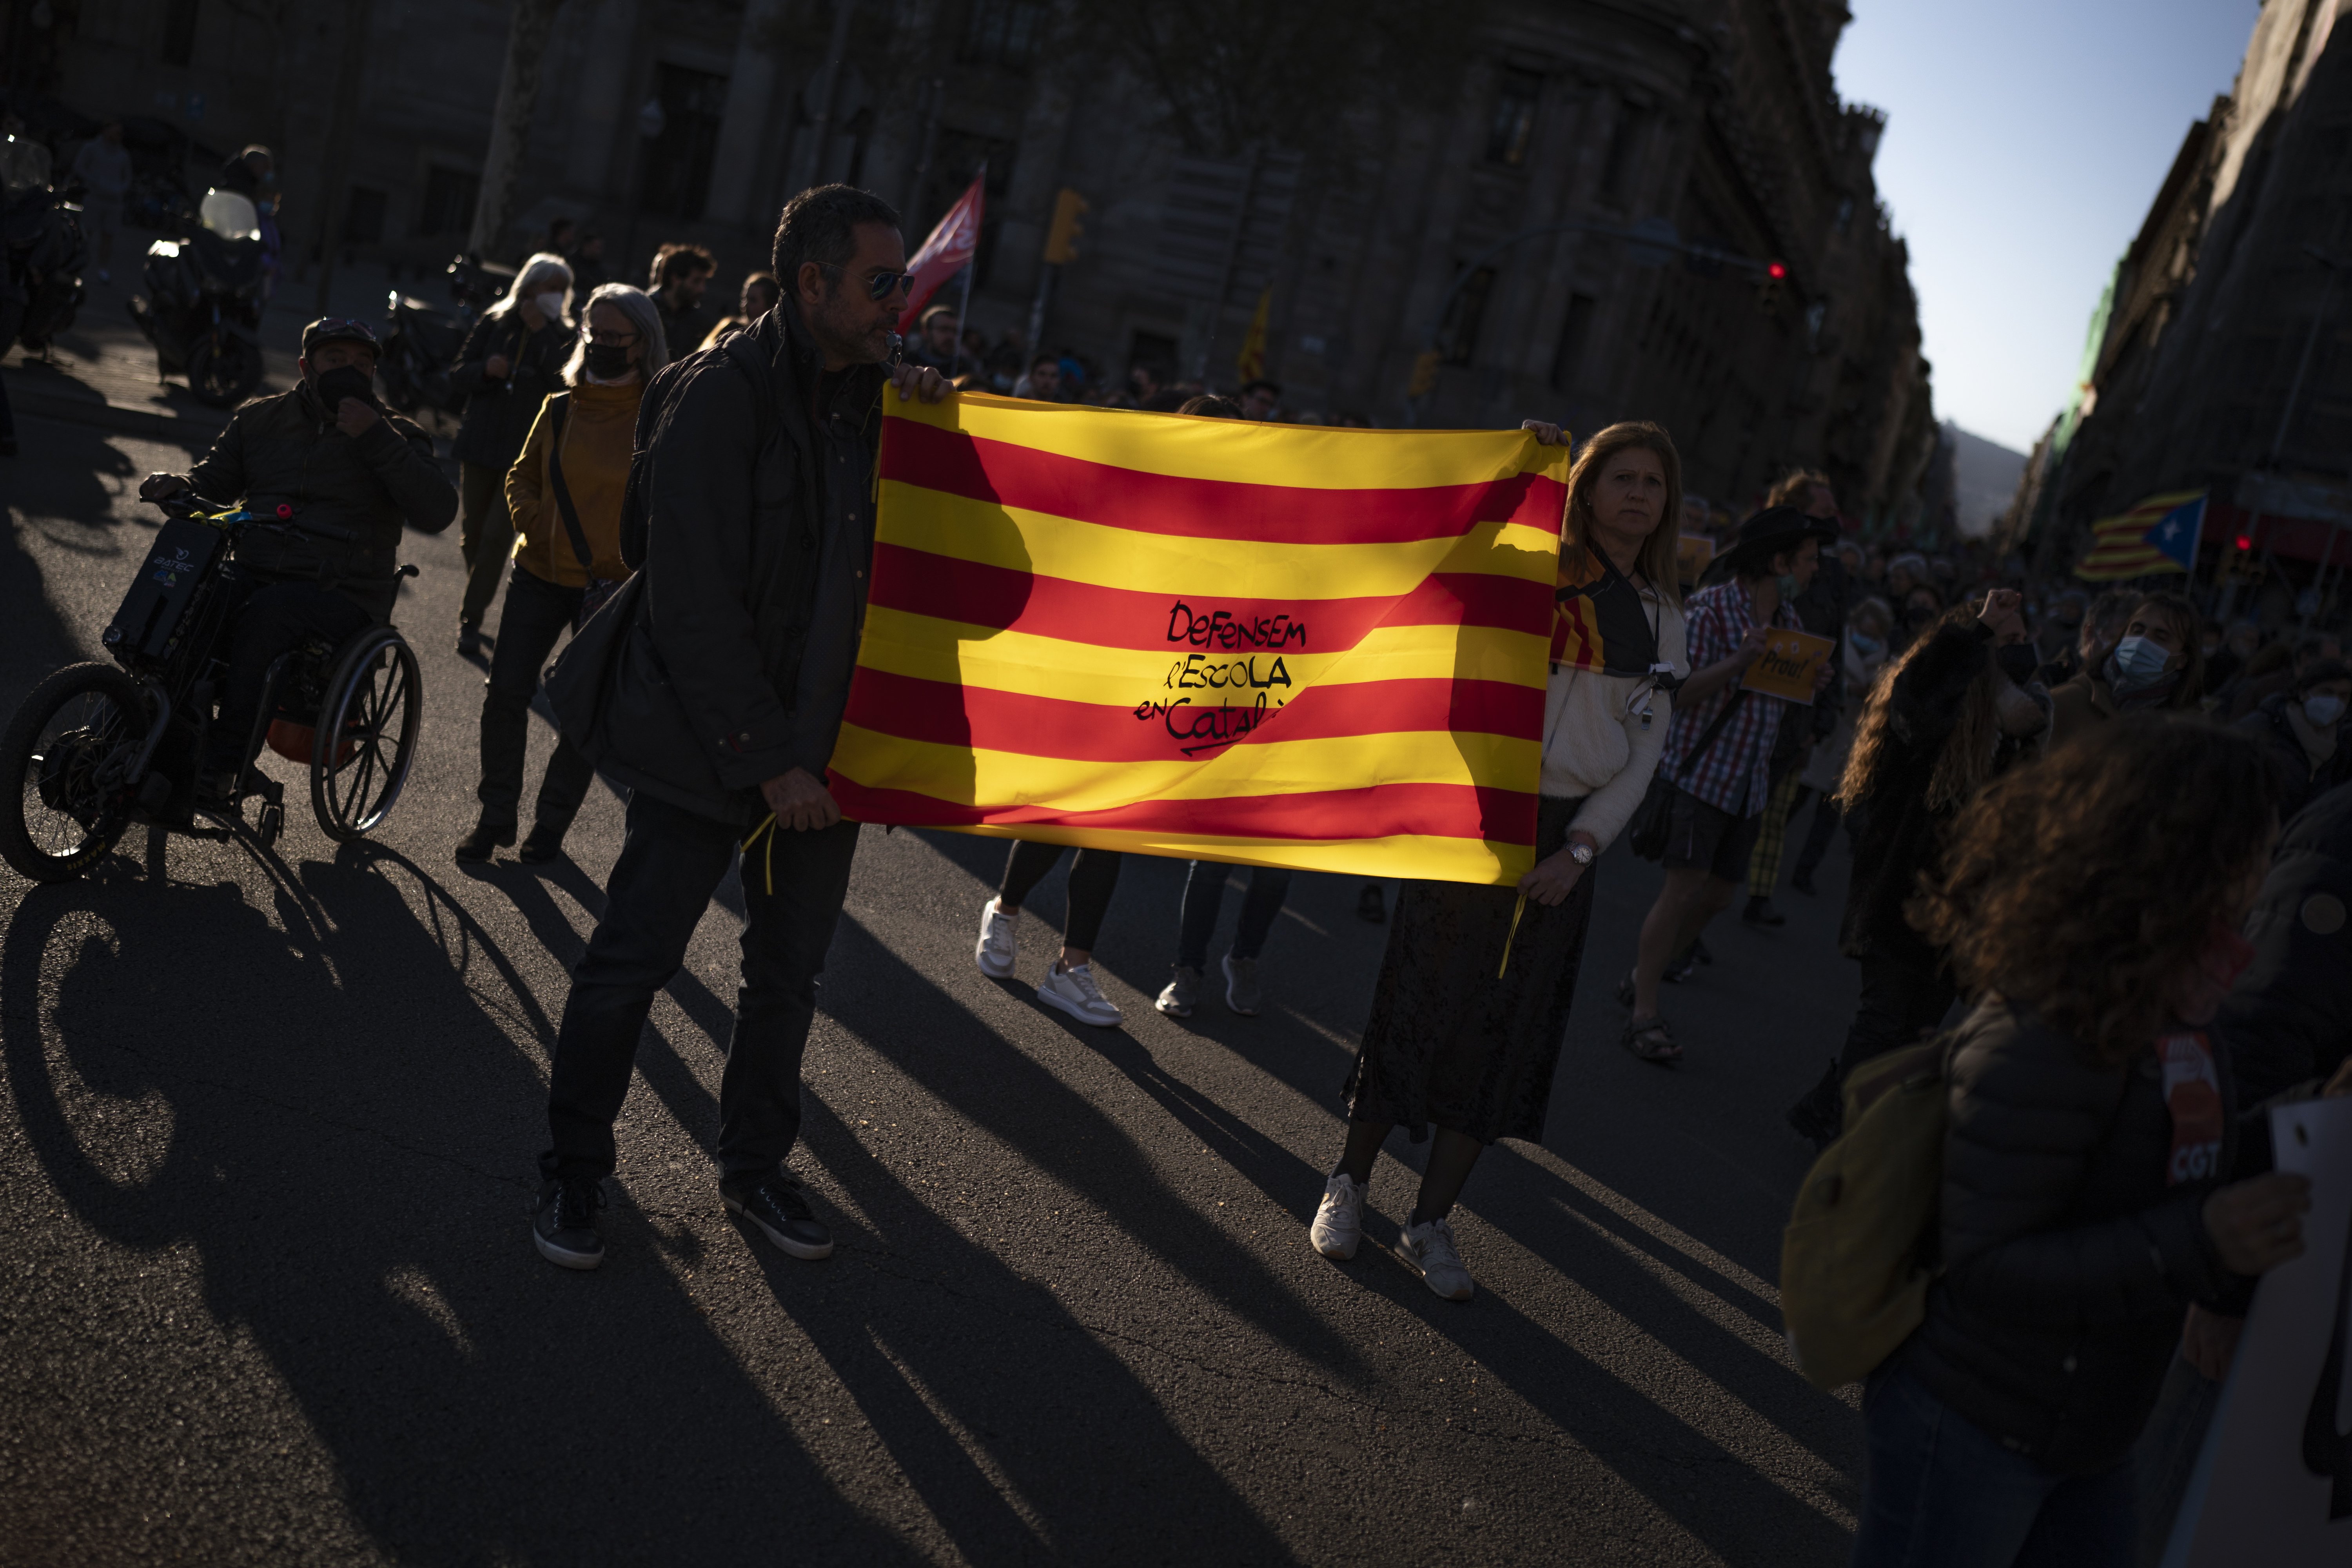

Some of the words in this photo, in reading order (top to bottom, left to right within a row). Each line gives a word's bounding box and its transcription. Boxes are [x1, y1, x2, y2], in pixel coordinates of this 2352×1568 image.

[154, 557, 194, 572] BATEC
[1760, 650, 1809, 679] Prou!
[66, 840, 107, 871] MAXXIS
[2171, 1141, 2221, 1183] CGT
